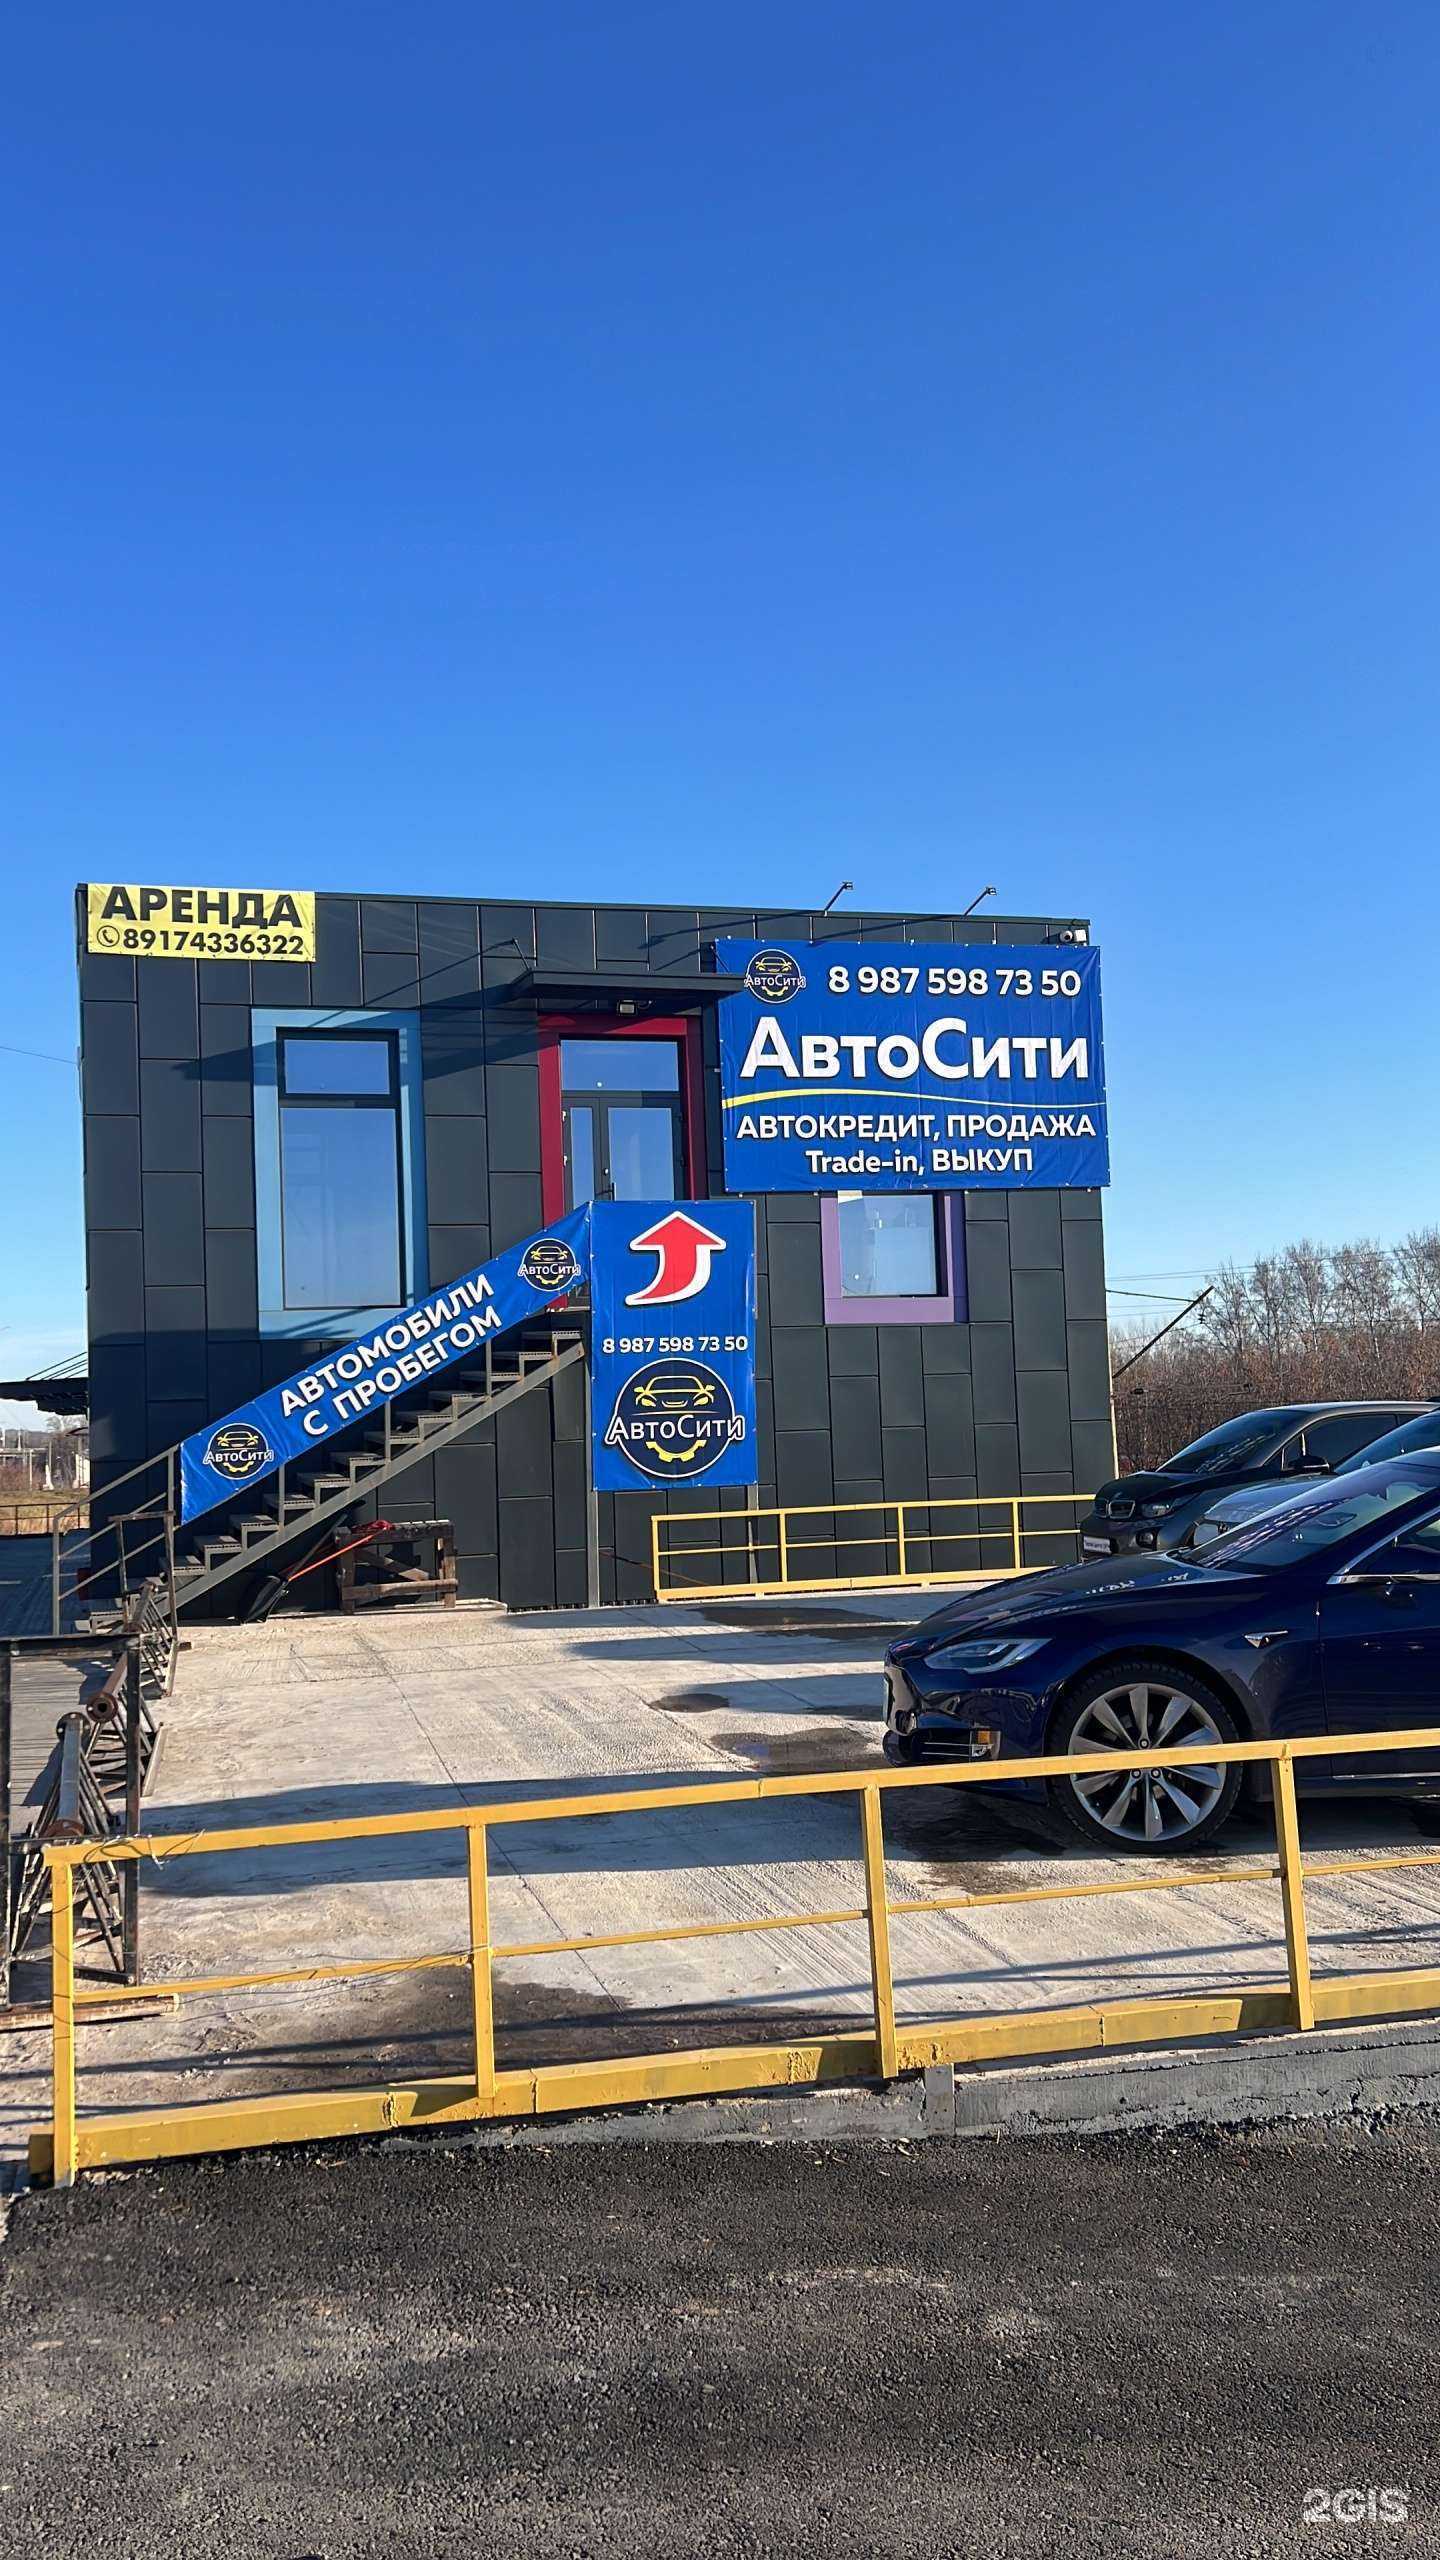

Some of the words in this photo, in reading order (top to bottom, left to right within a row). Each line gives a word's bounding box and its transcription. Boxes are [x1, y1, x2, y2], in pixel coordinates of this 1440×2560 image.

[101, 886, 302, 929] АРЕНДА
[123, 929, 304, 955] 89174336322
[828, 966, 850, 993] 8
[858, 966, 920, 994] 987
[928, 968, 988, 995] 598
[996, 969, 1033, 995] 73
[1041, 970, 1081, 996] 50
[740, 1016, 1089, 1079] АвтоСити
[736, 1114, 941, 1142] АВТОКРЕДИТ,
[947, 1114, 1097, 1142] ПРОДАЖА
[805, 1149, 925, 1176] Trade-in,
[932, 1149, 1033, 1172] ВЫКУП
[280, 1273, 494, 1417] АВТОМОБИЛИ
[602, 1338, 615, 1353] 8
[619, 1338, 655, 1353] 987
[658, 1337, 694, 1352] 598
[698, 1337, 720, 1351] 73
[724, 1336, 748, 1350] 50
[302, 1409, 329, 1436] С
[332, 1305, 502, 1420] ПРОБЕГОМ
